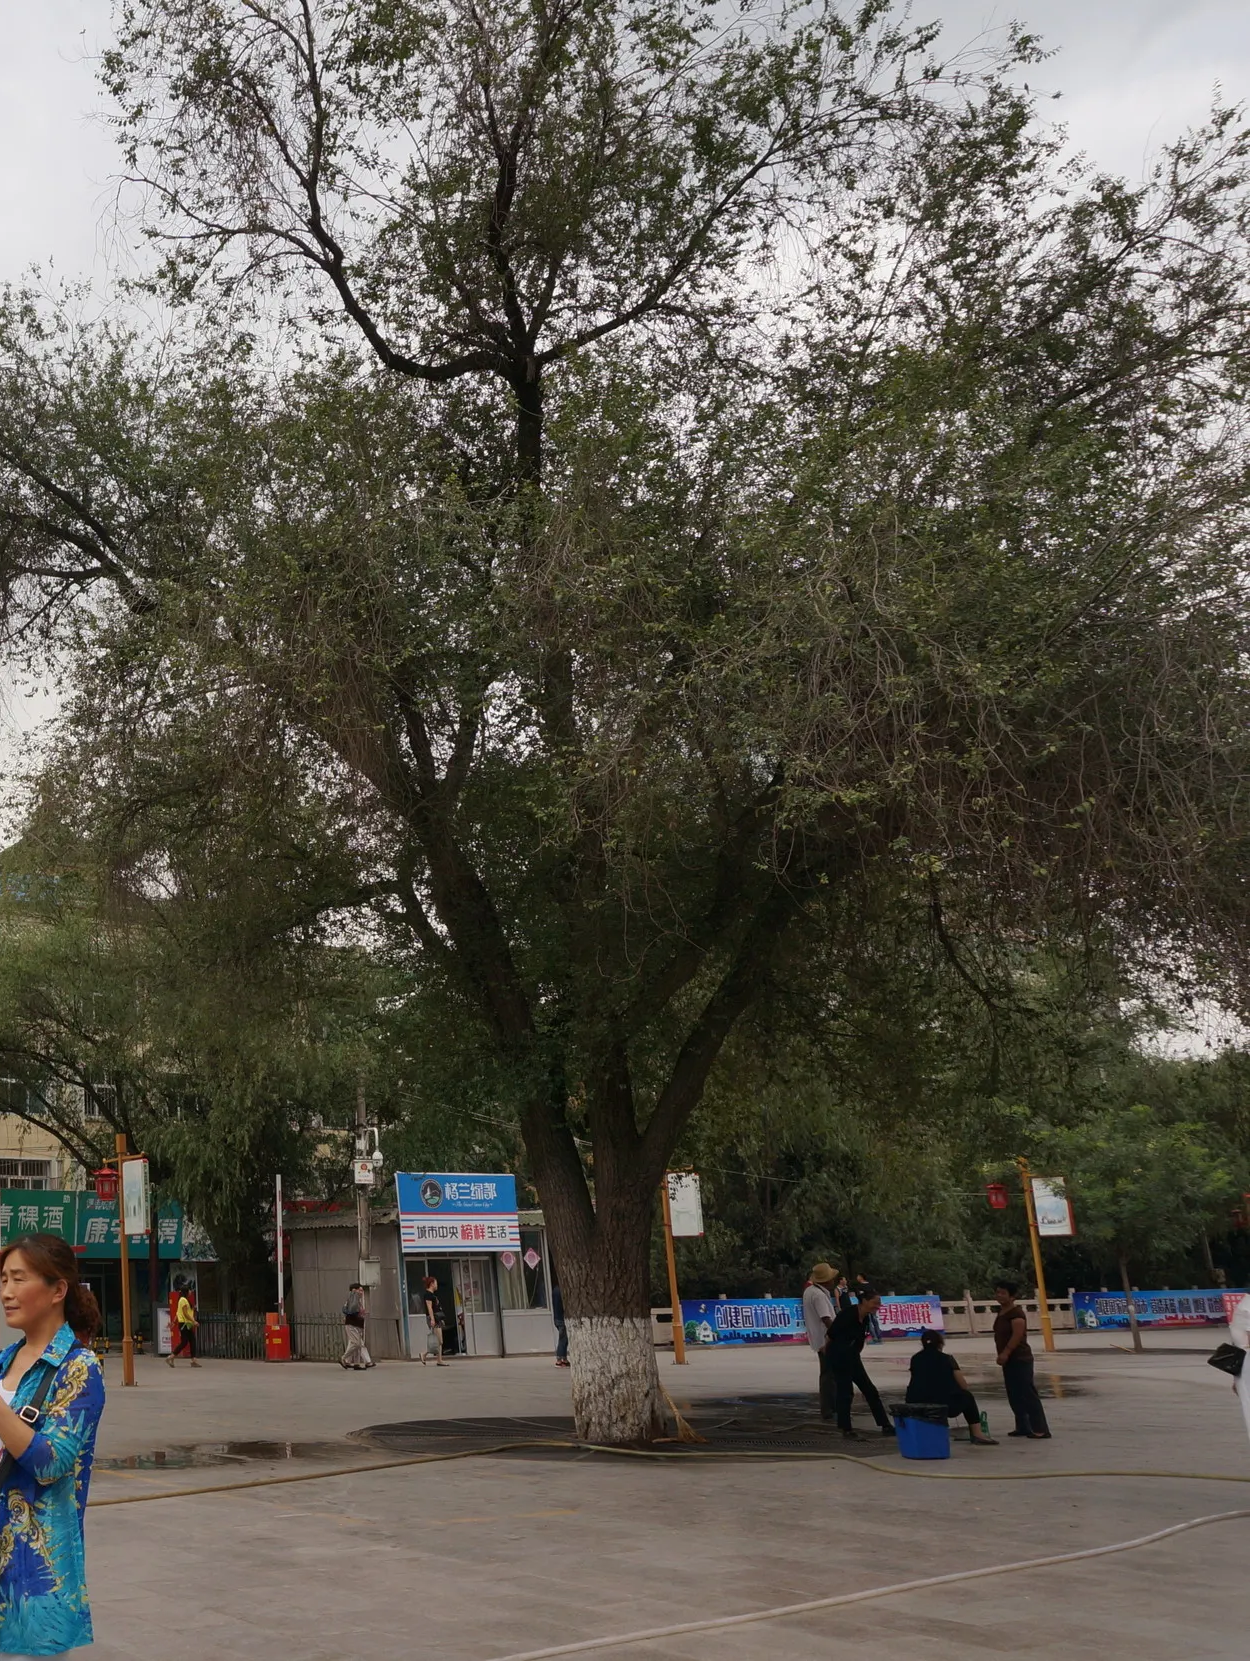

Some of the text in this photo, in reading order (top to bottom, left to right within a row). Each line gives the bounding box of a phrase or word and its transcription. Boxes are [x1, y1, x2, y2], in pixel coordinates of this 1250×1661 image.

[416, 1224, 507, 1241] 城市中央榜样生活
[715, 1304, 791, 1330] 创建园林城市
